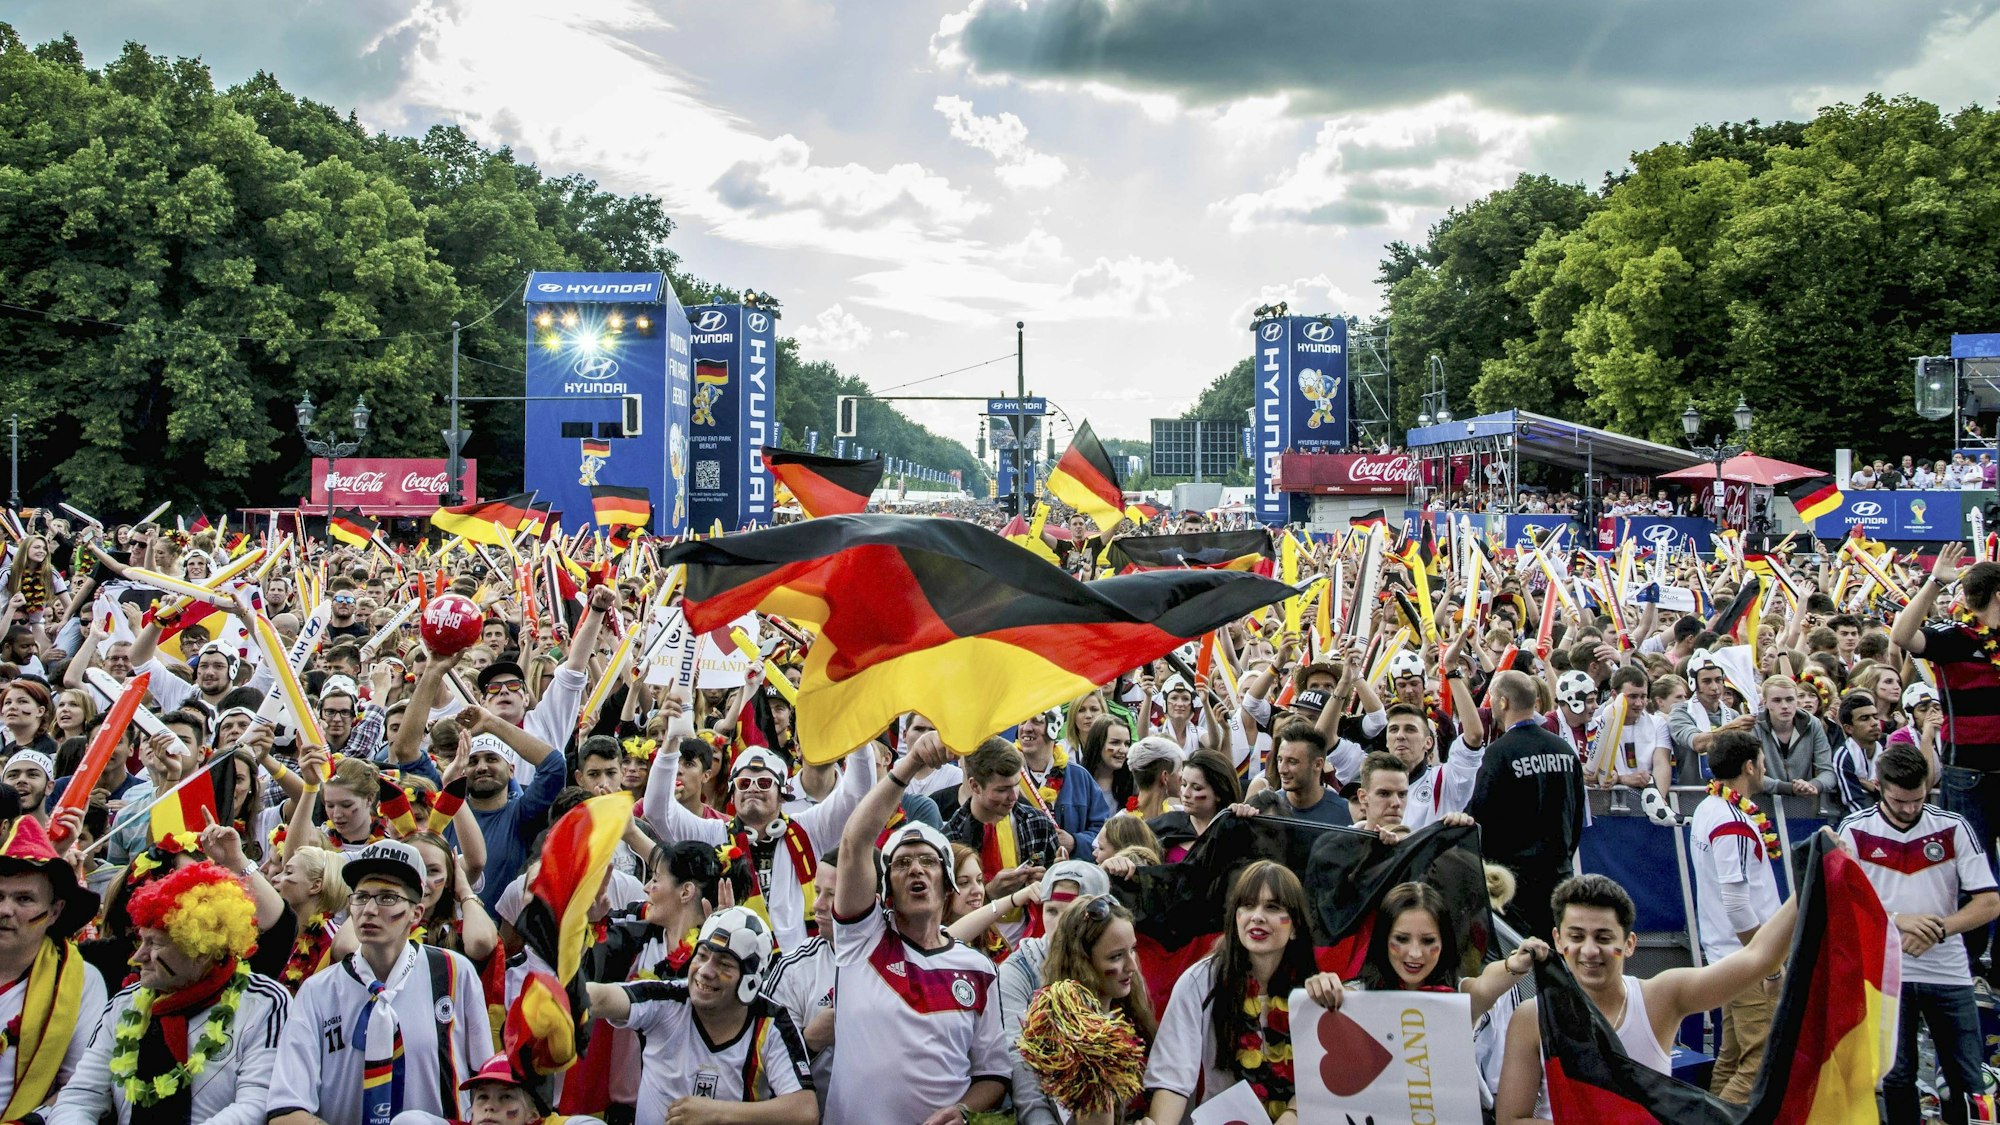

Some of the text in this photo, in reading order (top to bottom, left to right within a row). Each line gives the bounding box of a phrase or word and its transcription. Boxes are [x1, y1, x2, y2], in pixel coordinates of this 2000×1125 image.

[566, 283, 652, 294] HYUNDAI
[1298, 343, 1341, 354] HYUNDAI
[564, 382, 627, 394] HYUNDAI
[750, 339, 766, 513] HYUNDAI
[1264, 347, 1280, 511] HYUNDAI
[1349, 457, 1421, 482] Coca-Cola
[402, 472, 449, 493] Coca-Co
[1845, 516, 1888, 525] HYUNDAI
[270, 640, 309, 700] HYAI
[652, 655, 748, 673] DEUHLAND
[678, 630, 696, 687] UNDAI
[1512, 753, 1574, 778] SECURITY
[325, 1025, 346, 1054] 11
[369, 1117, 390, 1125] HYUN
